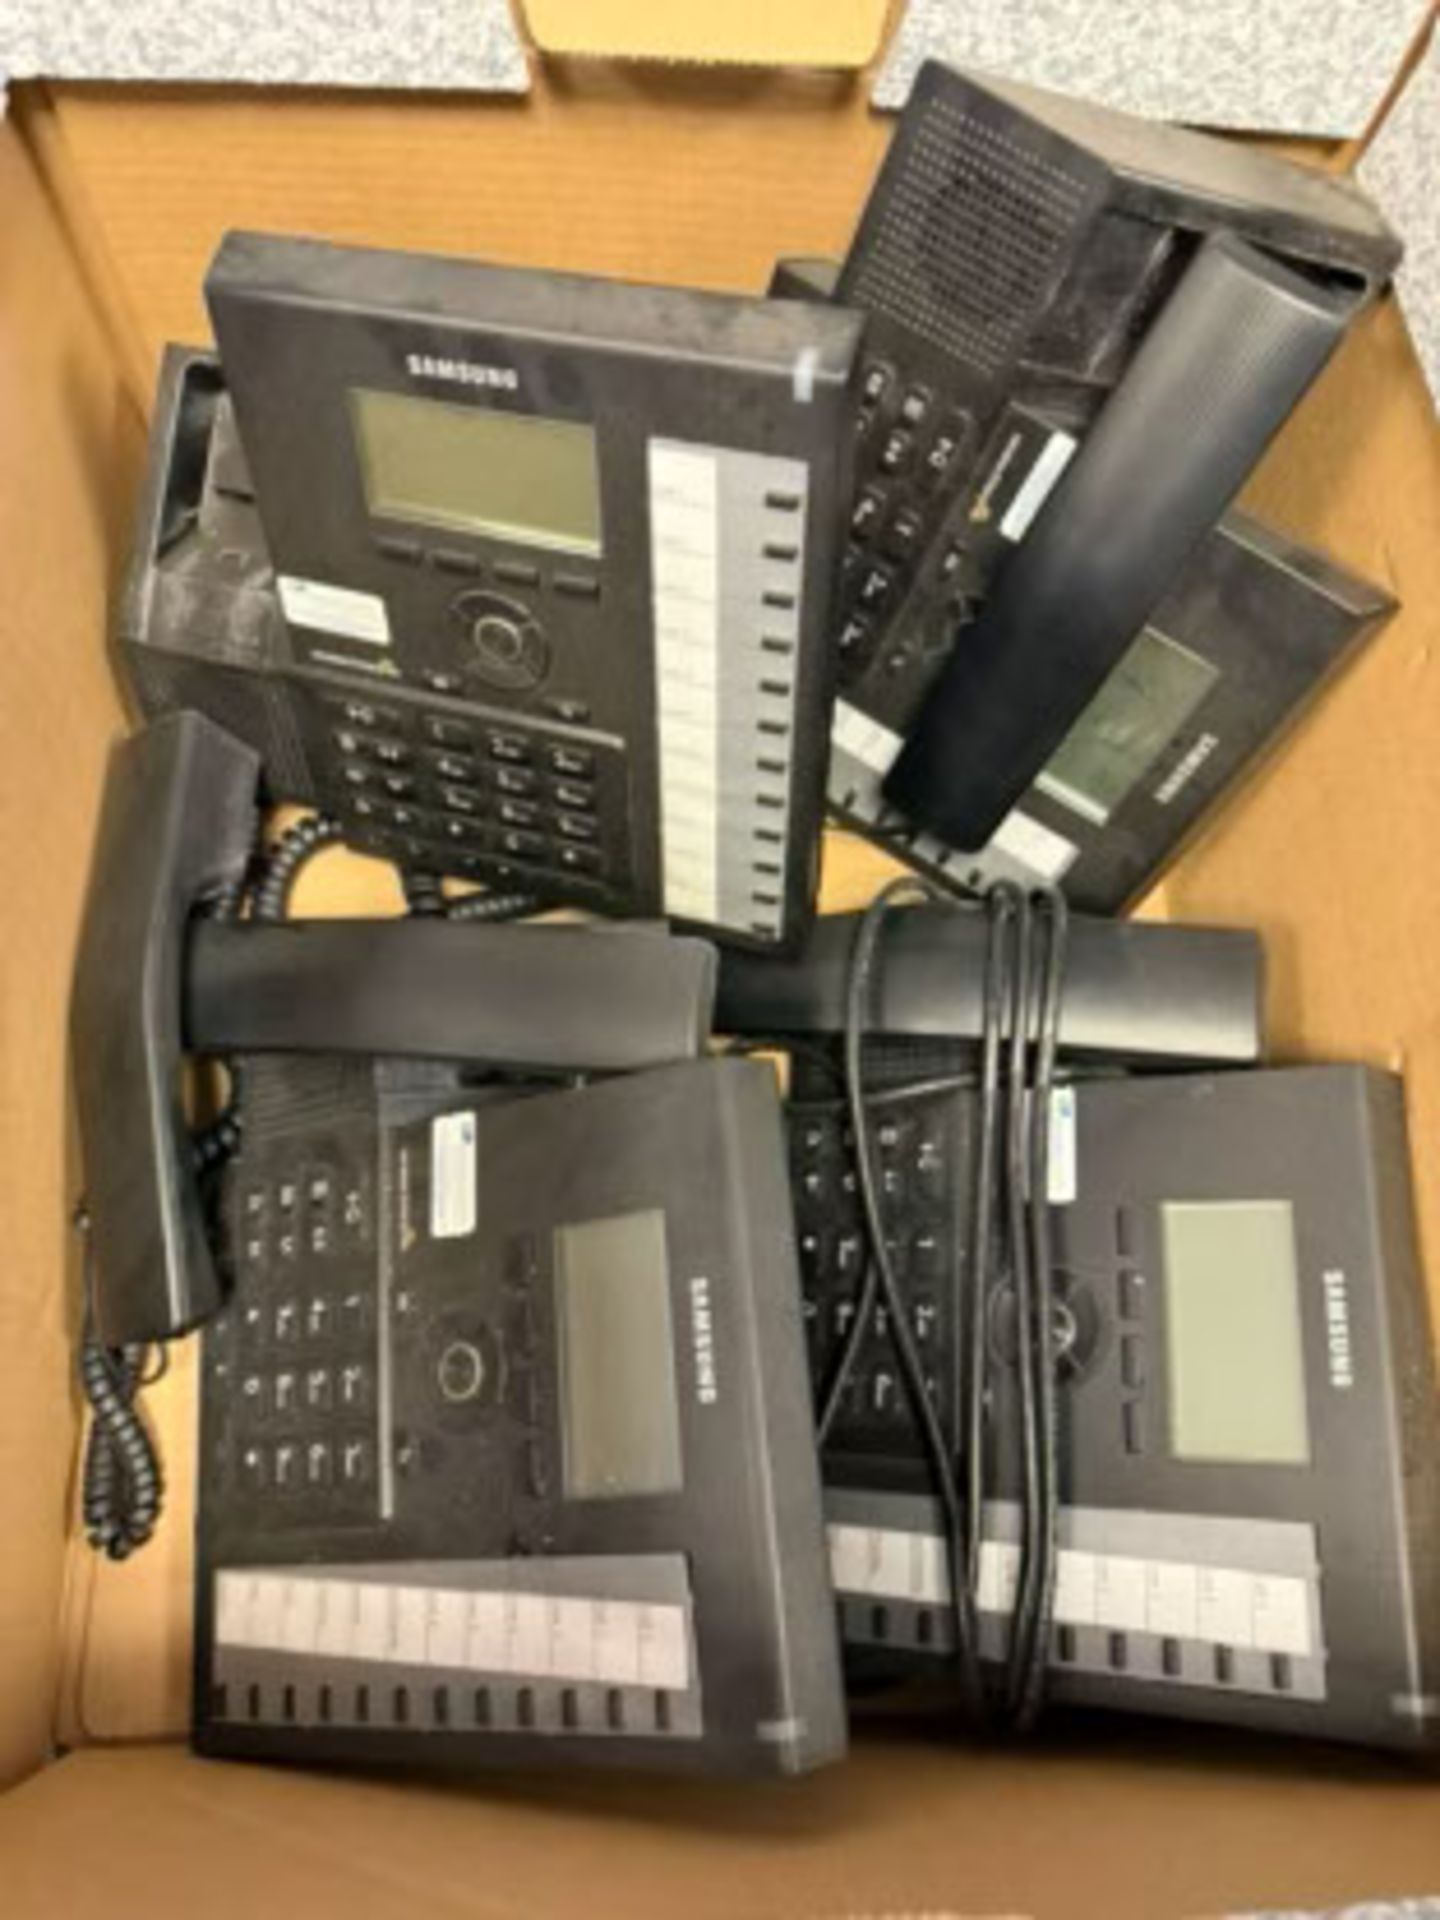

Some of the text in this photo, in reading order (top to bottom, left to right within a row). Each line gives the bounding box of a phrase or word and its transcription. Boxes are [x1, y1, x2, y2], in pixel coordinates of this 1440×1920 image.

[405, 354, 518, 390] SAMSUNG
[690, 1277, 718, 1403] SAMSUNG
[1322, 1269, 1354, 1387] SAMSUNG
